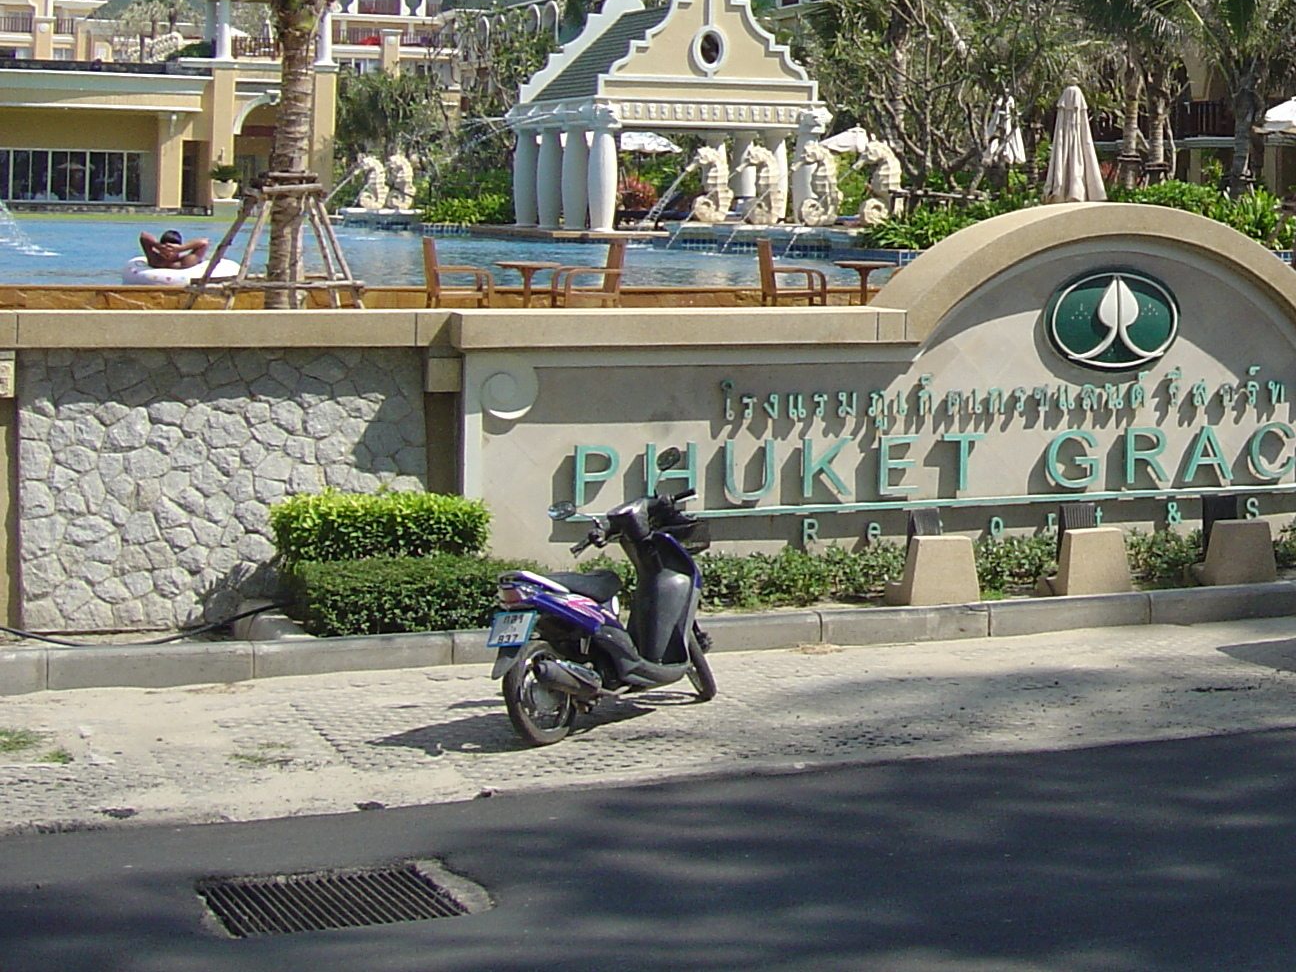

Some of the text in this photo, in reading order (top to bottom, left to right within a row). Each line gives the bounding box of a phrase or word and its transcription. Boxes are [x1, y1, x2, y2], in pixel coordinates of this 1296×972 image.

[721, 371, 1149, 430] โรงแรมภูเก็ตเกรซแลนด์
[1165, 366, 1286, 408] รีสอร์ท
[574, 432, 985, 505] PHUKET
[802, 506, 1103, 545] Reort
[1166, 501, 1183, 525] &
